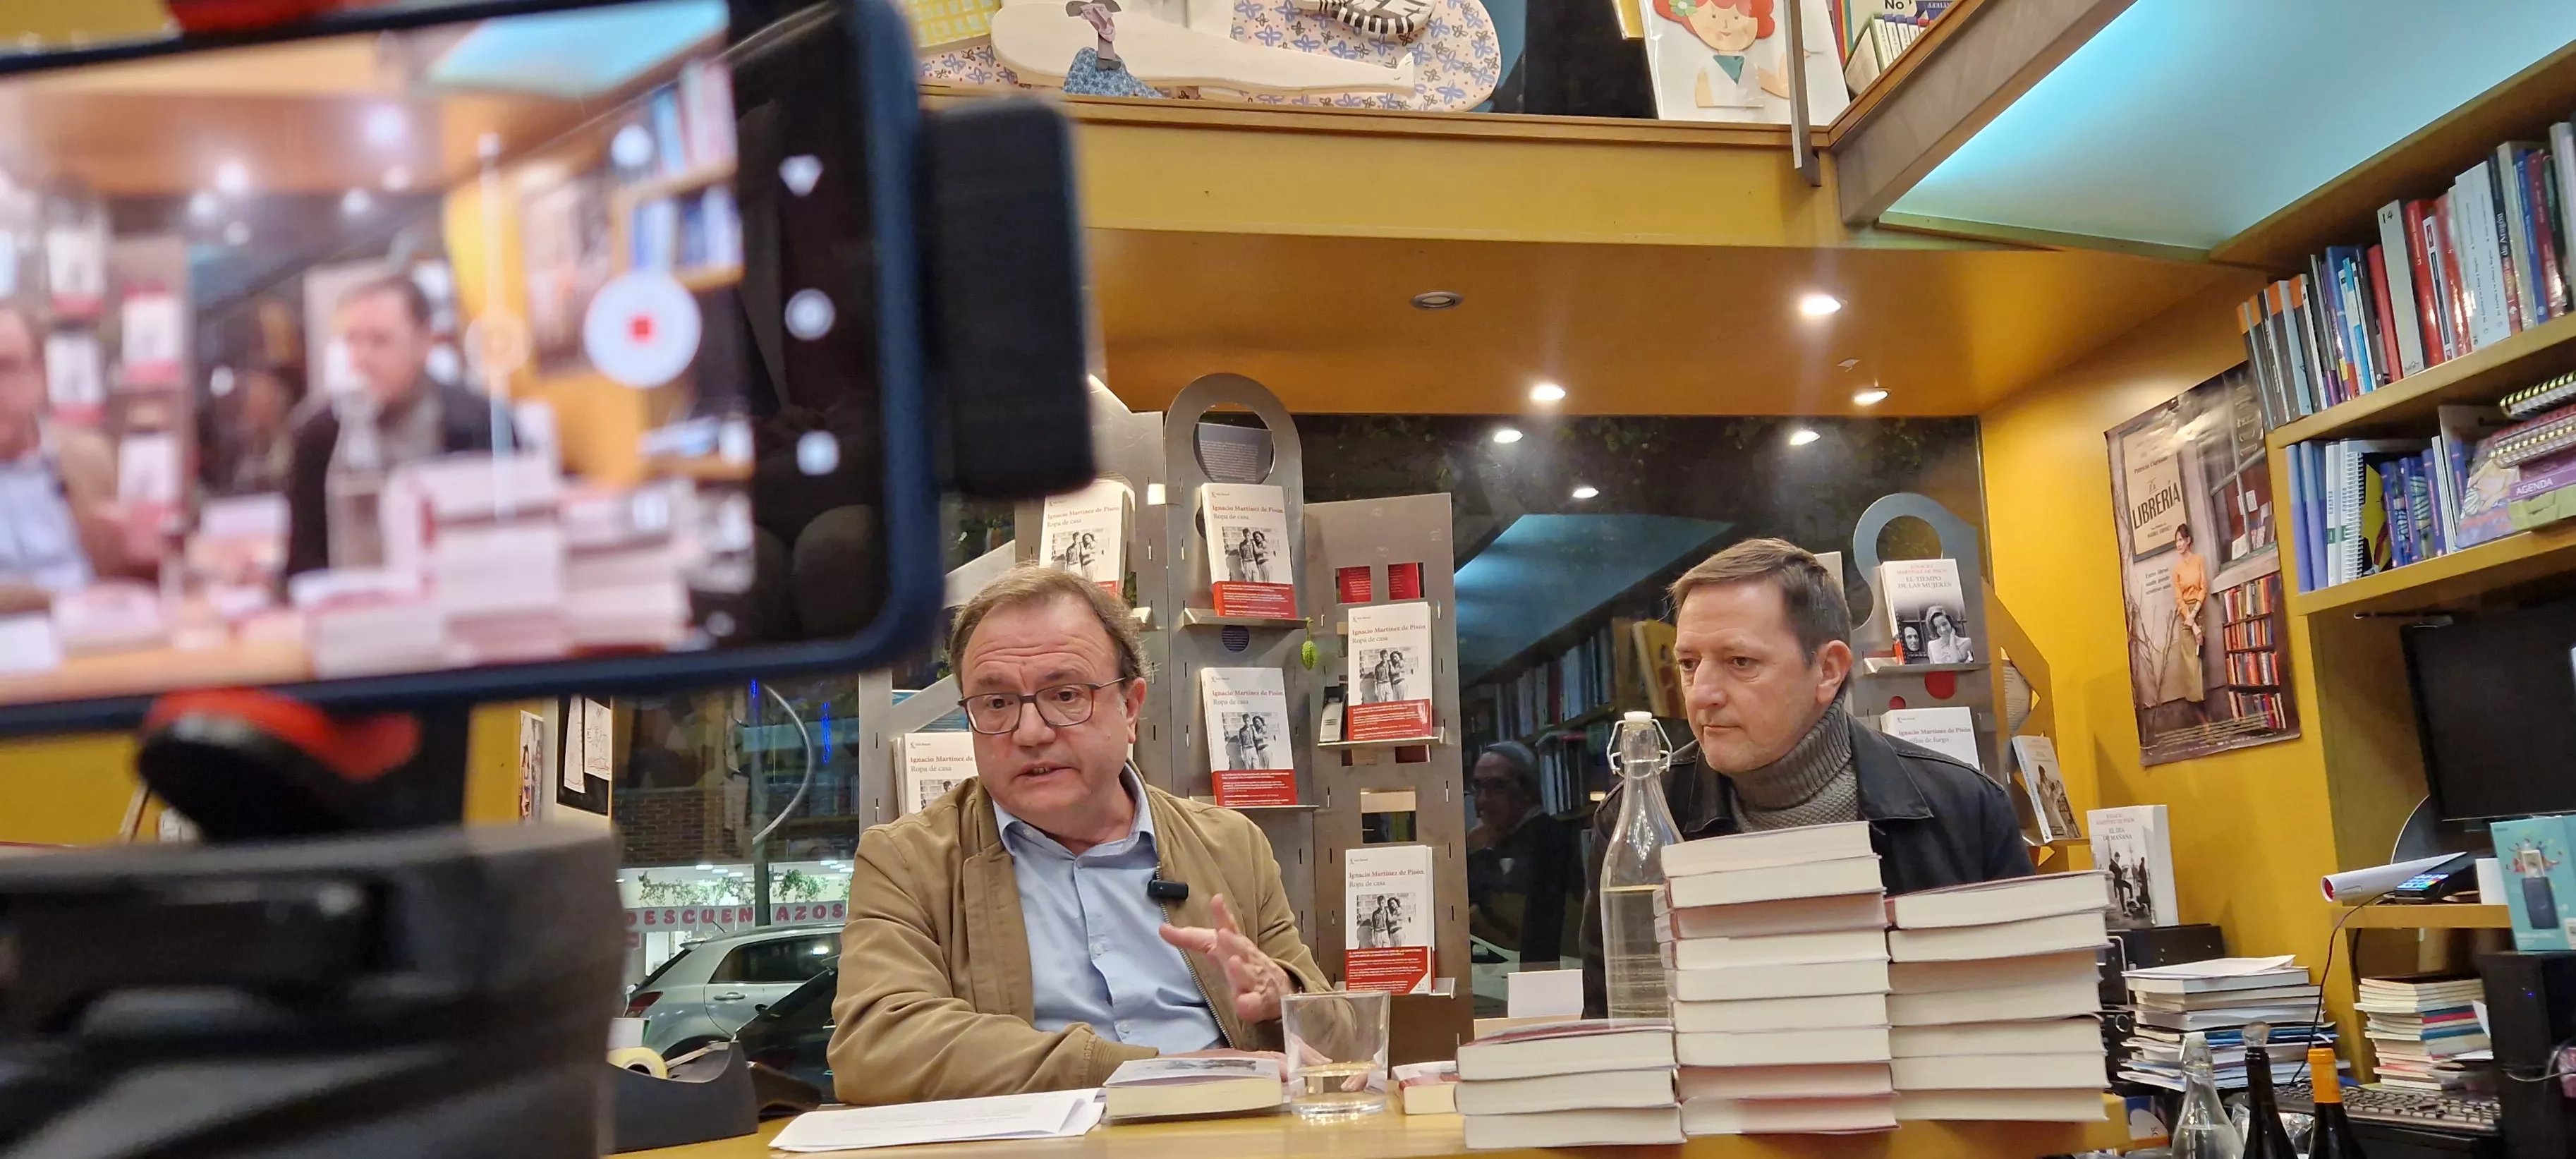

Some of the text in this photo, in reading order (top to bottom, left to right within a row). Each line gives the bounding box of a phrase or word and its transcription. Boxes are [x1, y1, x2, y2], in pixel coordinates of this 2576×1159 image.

[2496, 213, 2508, 244] Aragón
[2516, 478, 2553, 496] AGENDA
[2132, 480, 2181, 530] LIBRERÍA
[625, 904, 844, 926] DESCUENAZOS
